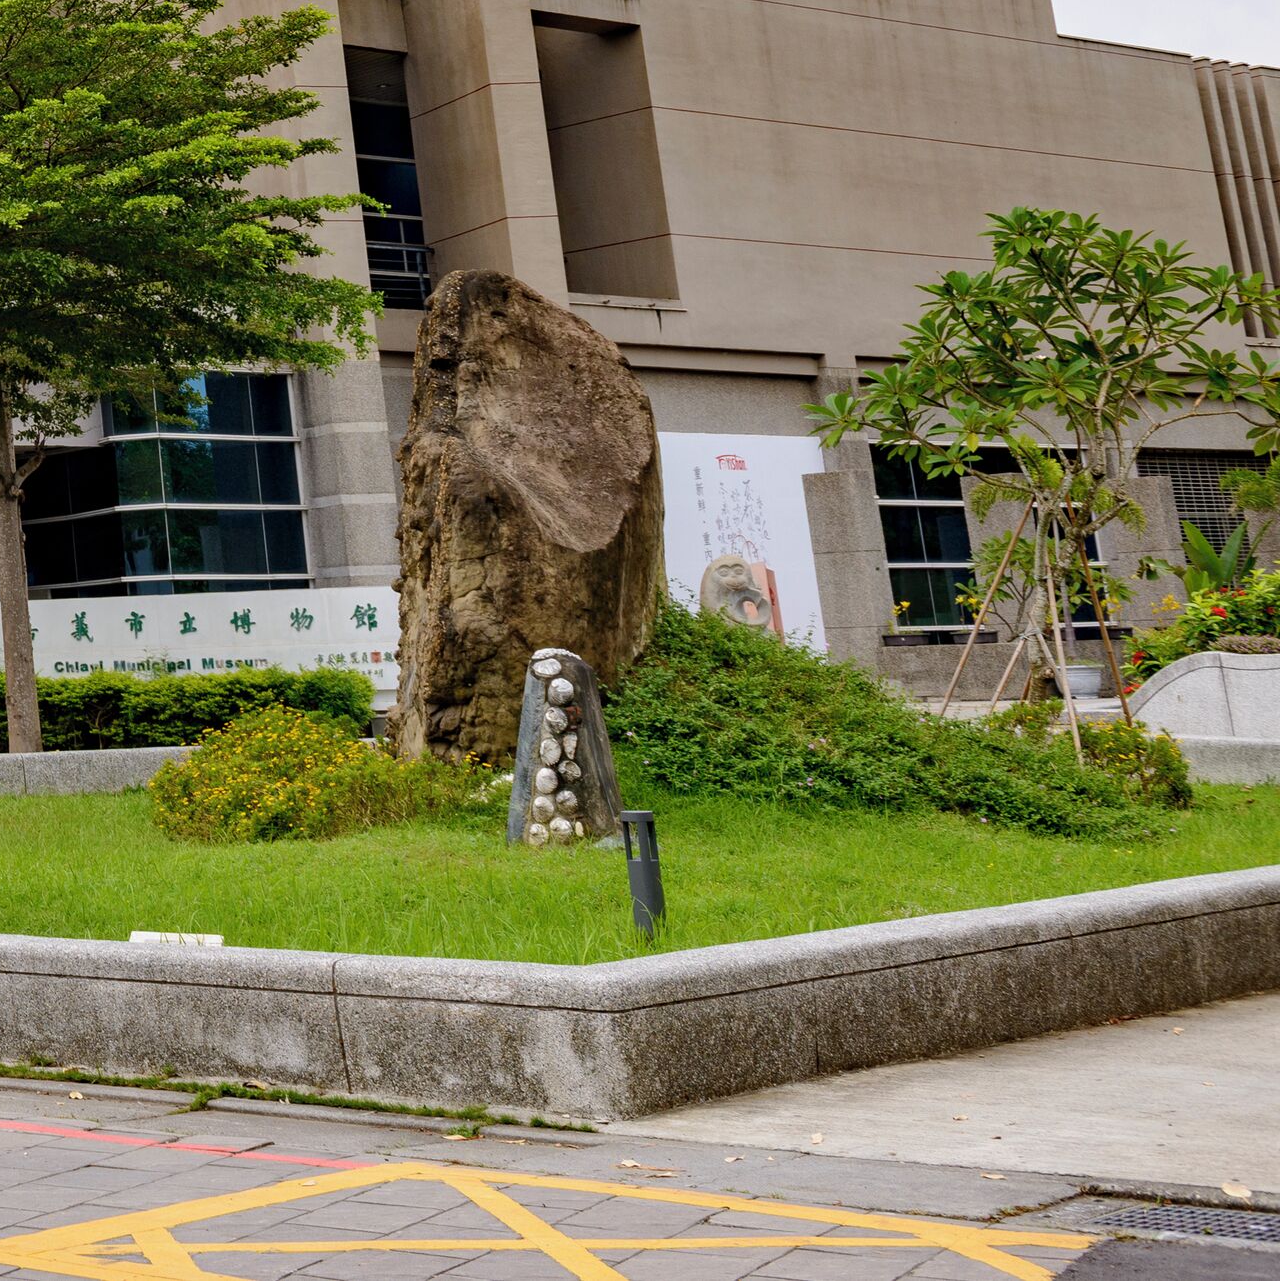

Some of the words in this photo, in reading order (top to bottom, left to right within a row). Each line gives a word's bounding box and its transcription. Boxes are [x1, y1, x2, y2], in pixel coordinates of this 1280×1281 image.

[31, 603, 378, 643] 義市立博物館
